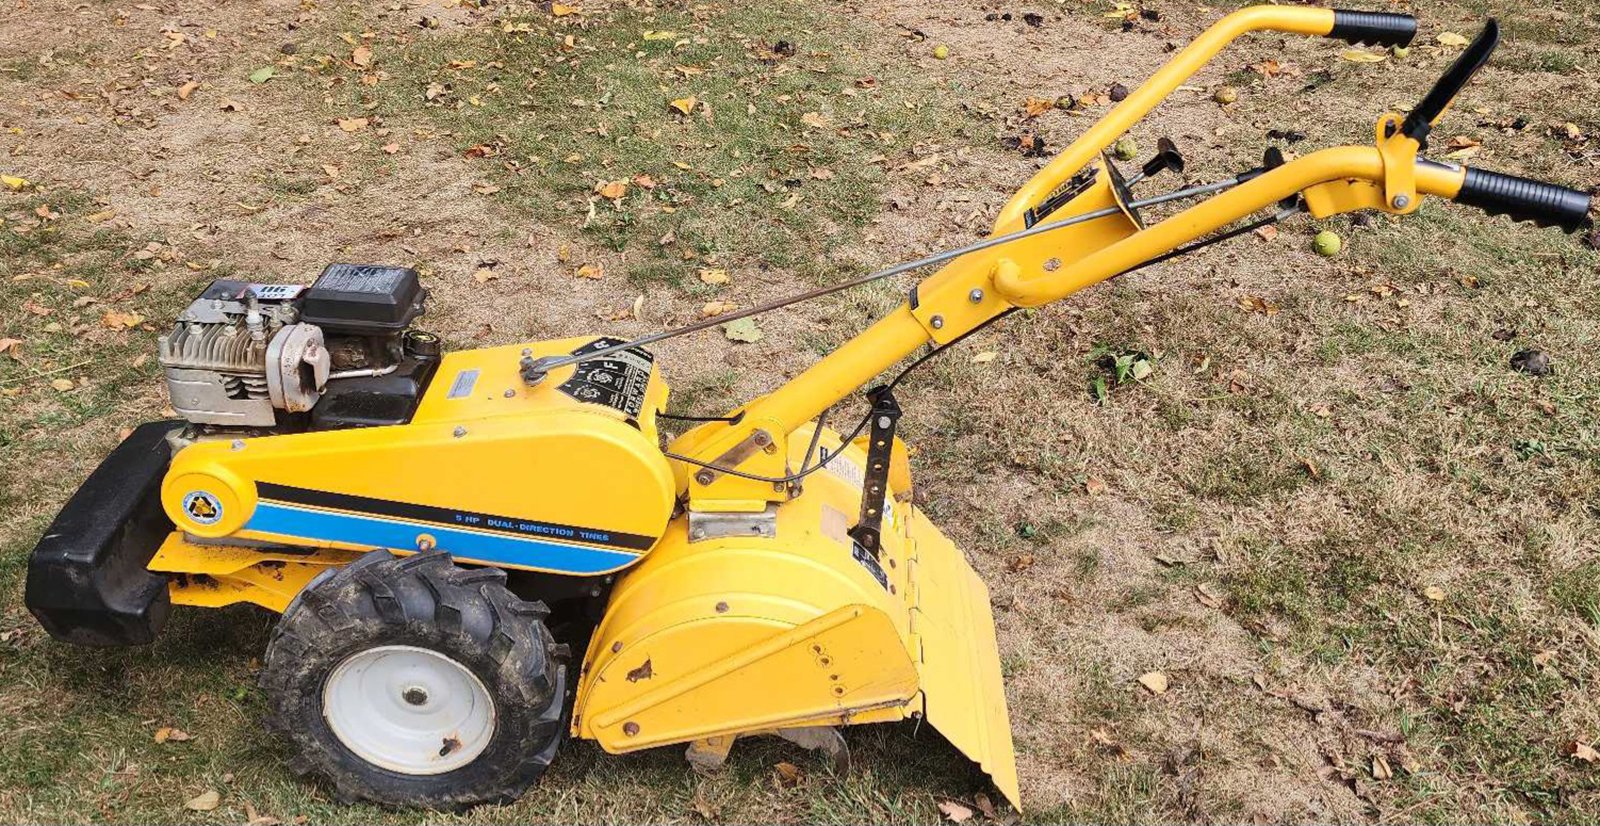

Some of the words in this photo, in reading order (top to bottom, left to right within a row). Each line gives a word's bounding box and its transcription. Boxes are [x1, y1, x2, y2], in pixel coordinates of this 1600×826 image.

[455, 514, 463, 522] 5
[464, 516, 480, 524] HP
[579, 531, 610, 541] TINES
